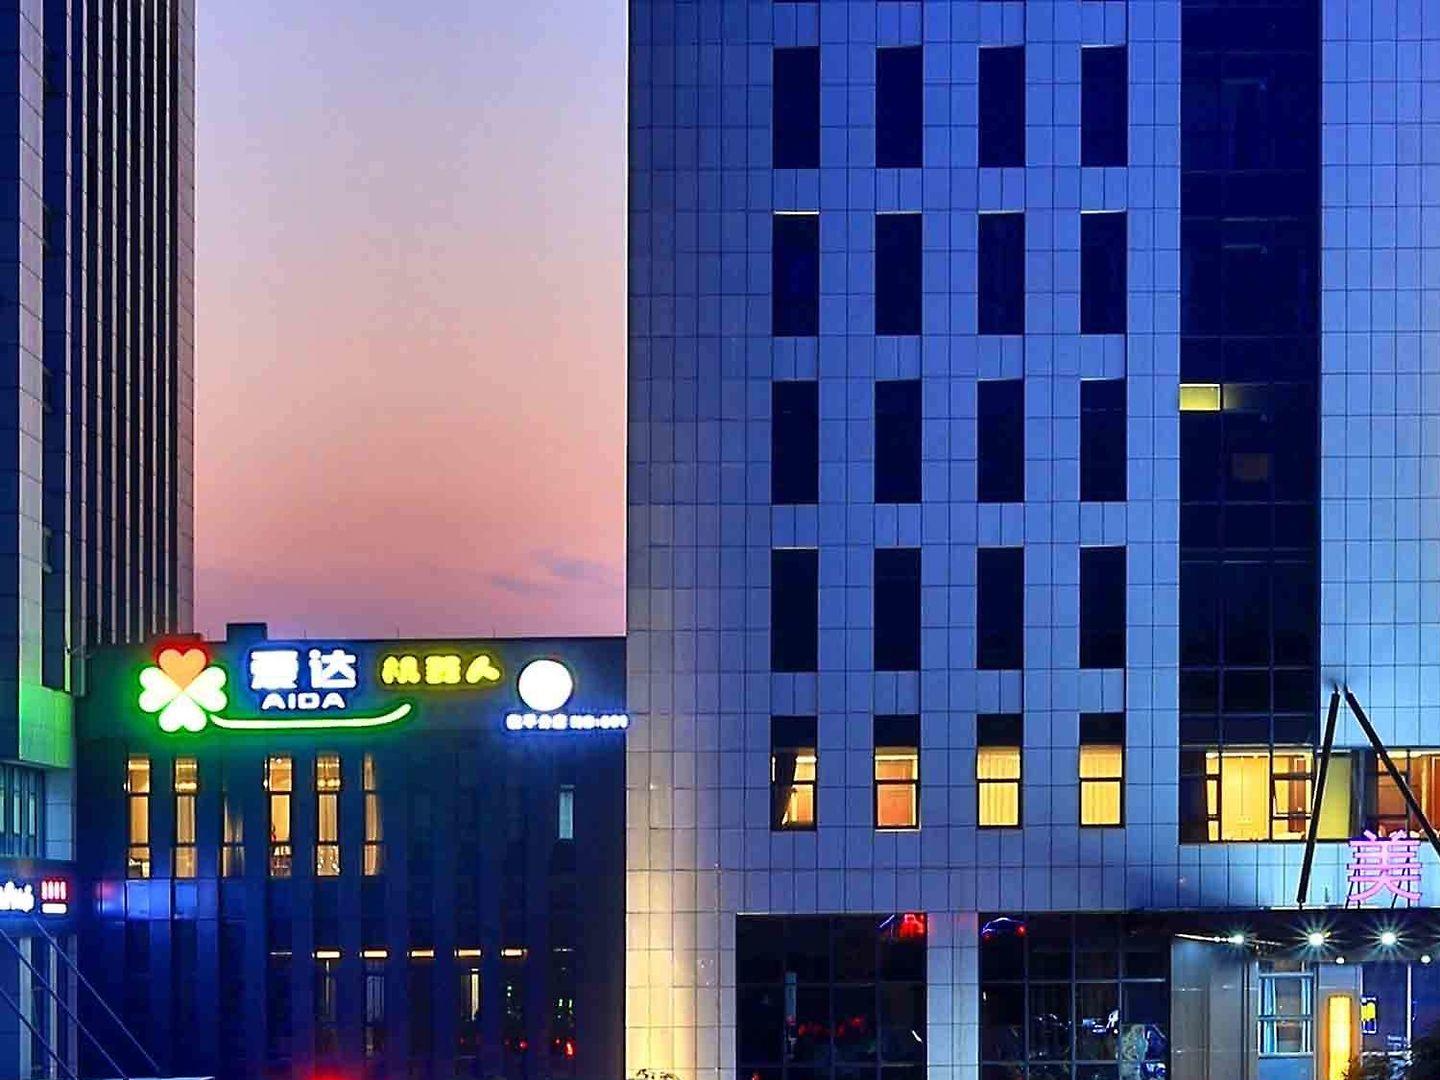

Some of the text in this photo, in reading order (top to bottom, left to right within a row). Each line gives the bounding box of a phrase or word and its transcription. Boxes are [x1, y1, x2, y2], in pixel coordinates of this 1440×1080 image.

[382, 655, 500, 685] 机器人
[261, 692, 346, 710] AIDA
